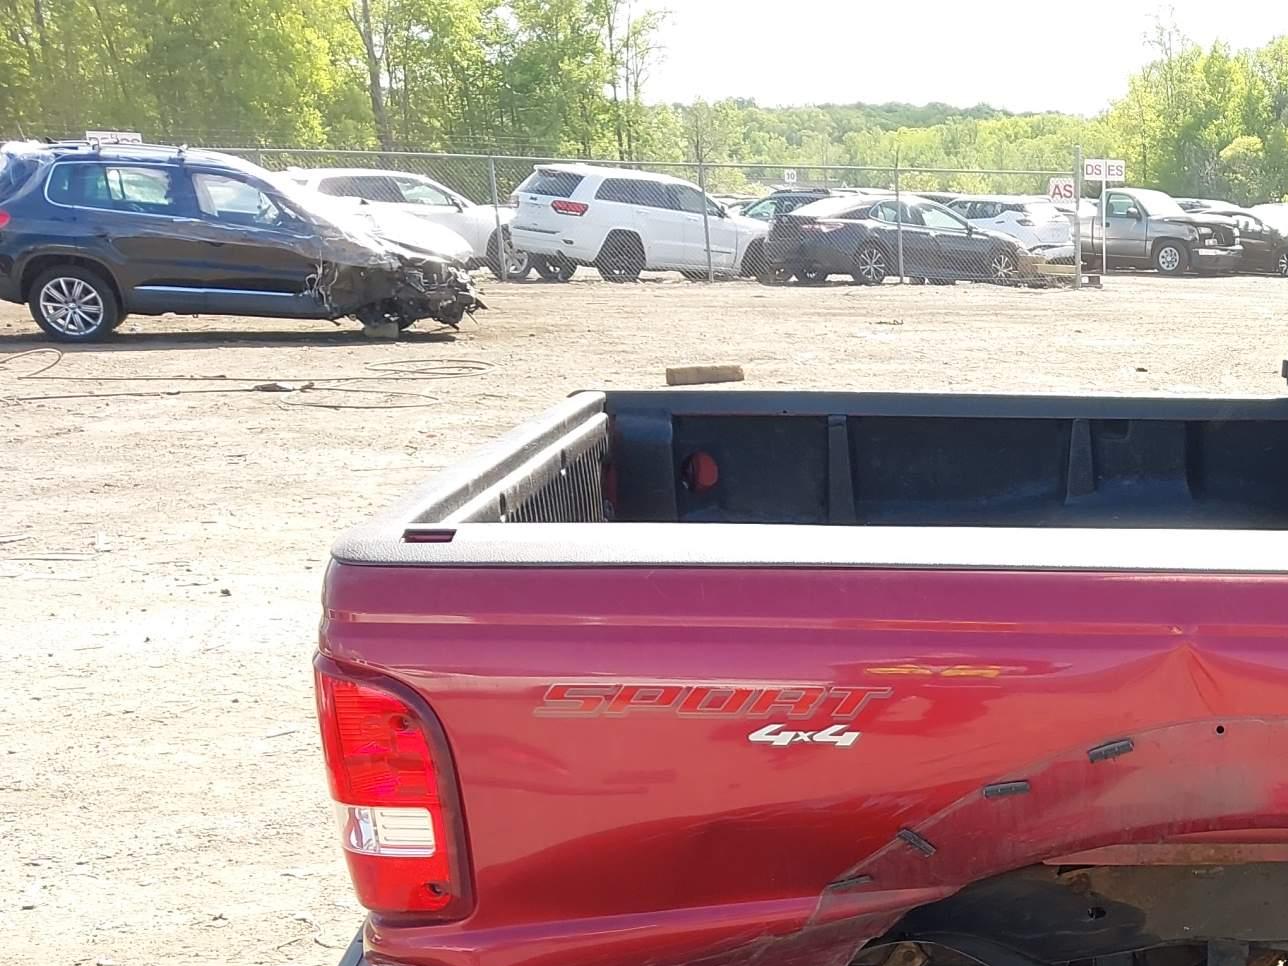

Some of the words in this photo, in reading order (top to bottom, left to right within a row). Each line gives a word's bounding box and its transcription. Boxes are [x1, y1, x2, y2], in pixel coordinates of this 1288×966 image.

[787, 172, 795, 180] 10
[1086, 164, 1102, 176] DS
[1108, 165, 1124, 177] ES
[1051, 184, 1073, 199] AS
[533, 683, 892, 719] SPORT
[748, 724, 860, 747] 4x4
